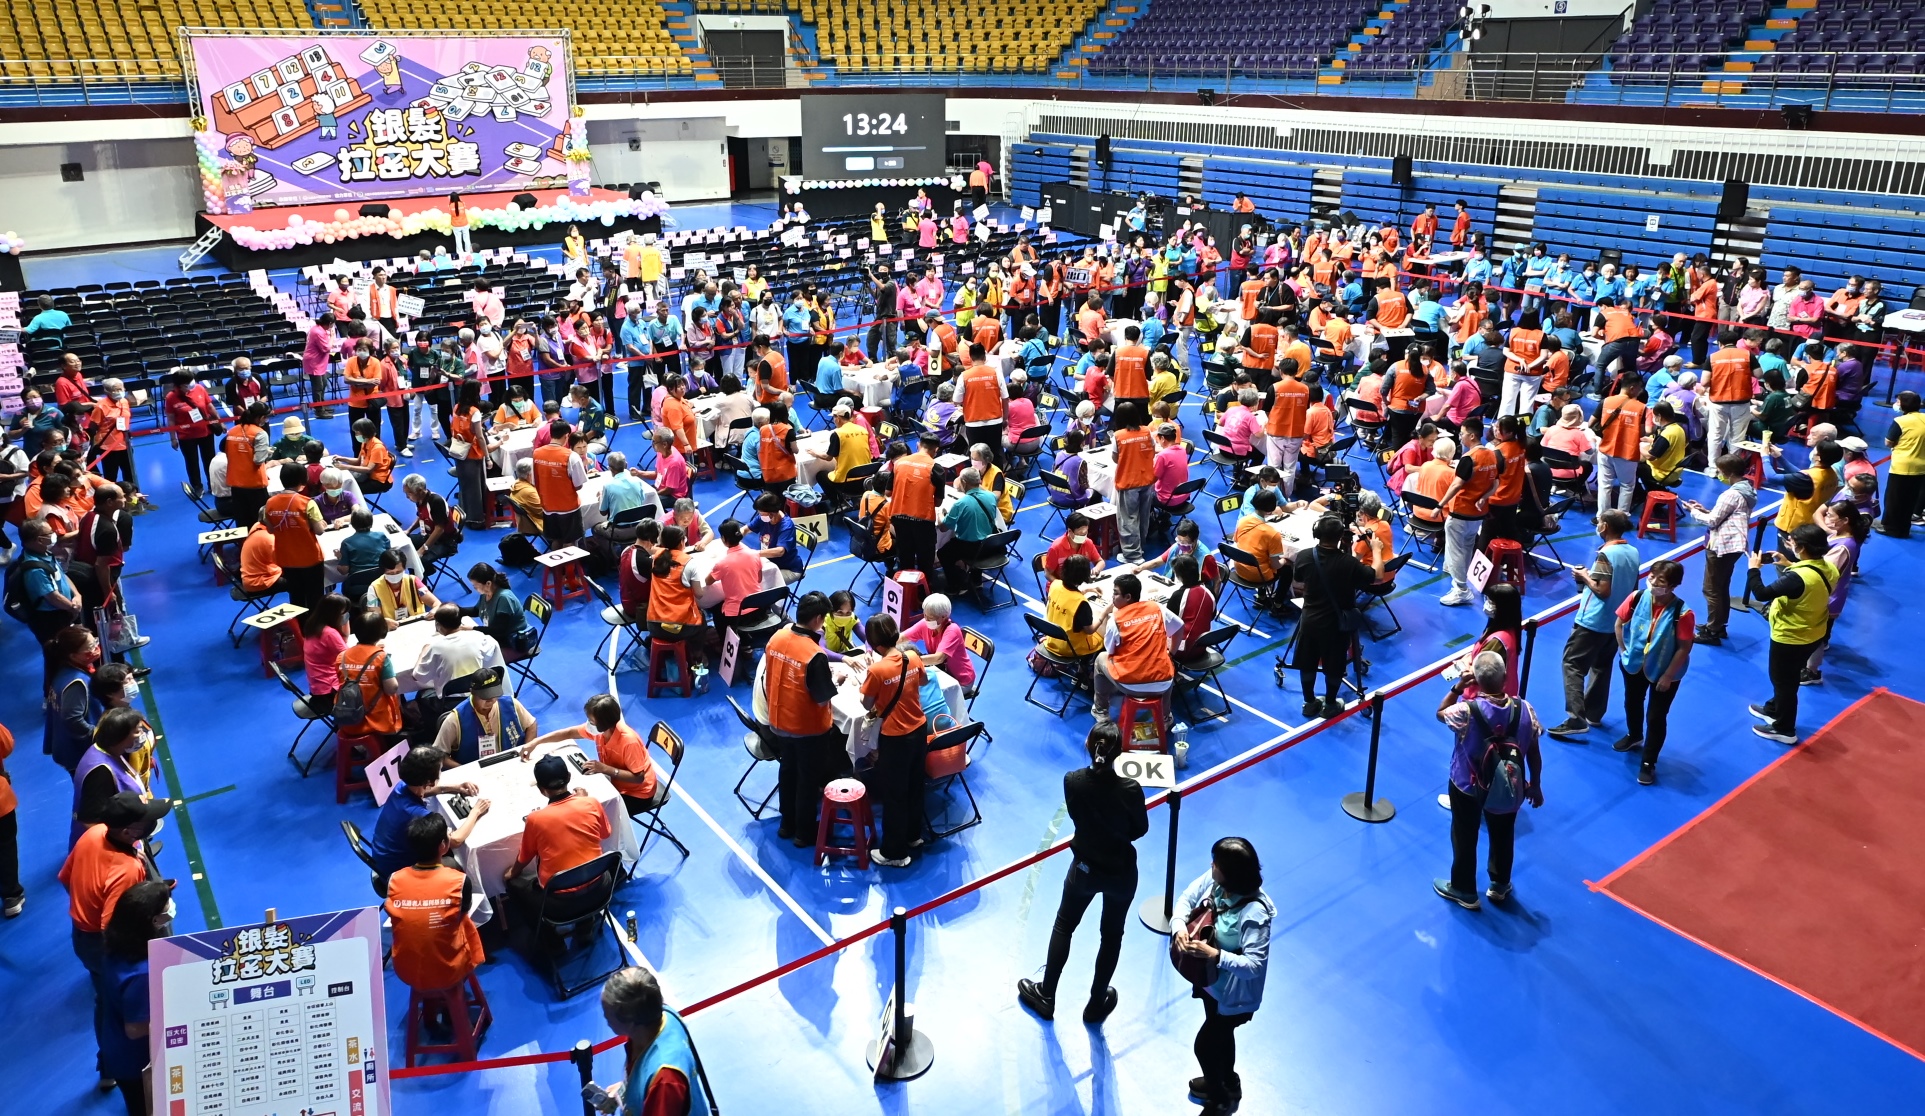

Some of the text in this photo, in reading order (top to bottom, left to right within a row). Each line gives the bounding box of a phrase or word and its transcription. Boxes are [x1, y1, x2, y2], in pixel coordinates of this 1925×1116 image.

[374, 42, 386, 54] 3
[309, 50, 322, 62] 13
[286, 62, 299, 74] 12
[530, 62, 542, 72] 12
[259, 75, 269, 88] 7
[321, 71, 332, 82] 4
[493, 72, 506, 82] 12
[233, 89, 246, 103] 6
[287, 88, 299, 99] 2
[335, 86, 346, 98] 11
[282, 113, 294, 127] 8
[370, 107, 443, 143] 銀髮
[843, 113, 908, 136] 13:24
[337, 142, 481, 182] 拉密大賽
[1009, 485, 1014, 493] 4
[205, 530, 238, 540] OK
[799, 533, 805, 542] 4
[534, 603, 541, 614] 4
[887, 590, 899, 615] 19
[256, 608, 295, 624] OK
[972, 638, 978, 650] 4
[723, 641, 735, 669] 18
[663, 736, 669, 749] 4
[379, 754, 402, 788] 17
[1122, 760, 1165, 779] OK
[238, 924, 288, 954] 銀髮
[212, 944, 316, 983] 拉密大賽
[250, 986, 275, 999] 舞台
[166, 1028, 187, 1037] 巨大化
[348, 1039, 358, 1062] 茶水
[172, 1068, 182, 1092] 茶水
[351, 1088, 362, 1116] 交流
